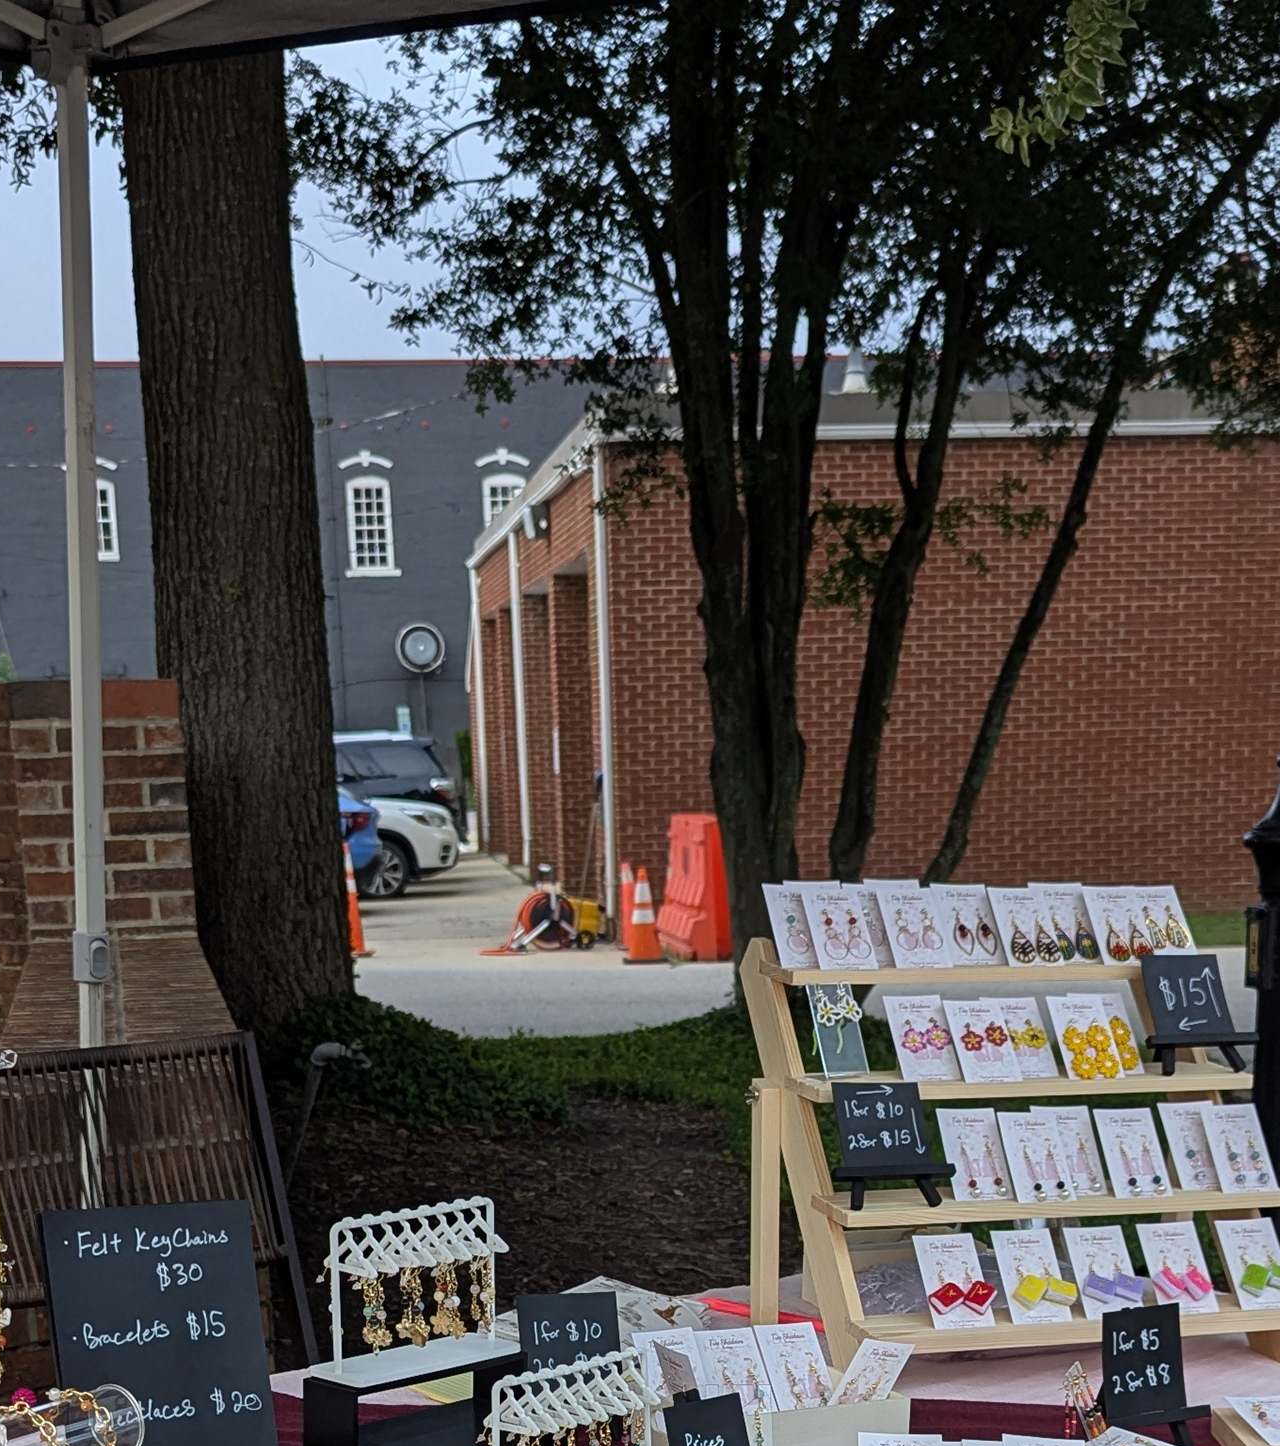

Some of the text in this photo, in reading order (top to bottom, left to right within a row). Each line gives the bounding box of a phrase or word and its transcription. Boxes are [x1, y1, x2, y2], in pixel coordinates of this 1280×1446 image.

[1159, 976, 1206, 1011] $15
[875, 1101, 903, 1119] $10
[879, 1129, 911, 1148] $15
[77, 1231, 121, 1258] Felt
[156, 1262, 202, 1291] $30
[83, 1310, 226, 1349] Bracelets $15
[566, 1319, 602, 1342] $10
[1140, 1328, 1160, 1350] $5
[1112, 1363, 1170, 1394] 2 for $8
[210, 1387, 262, 1415] $20
